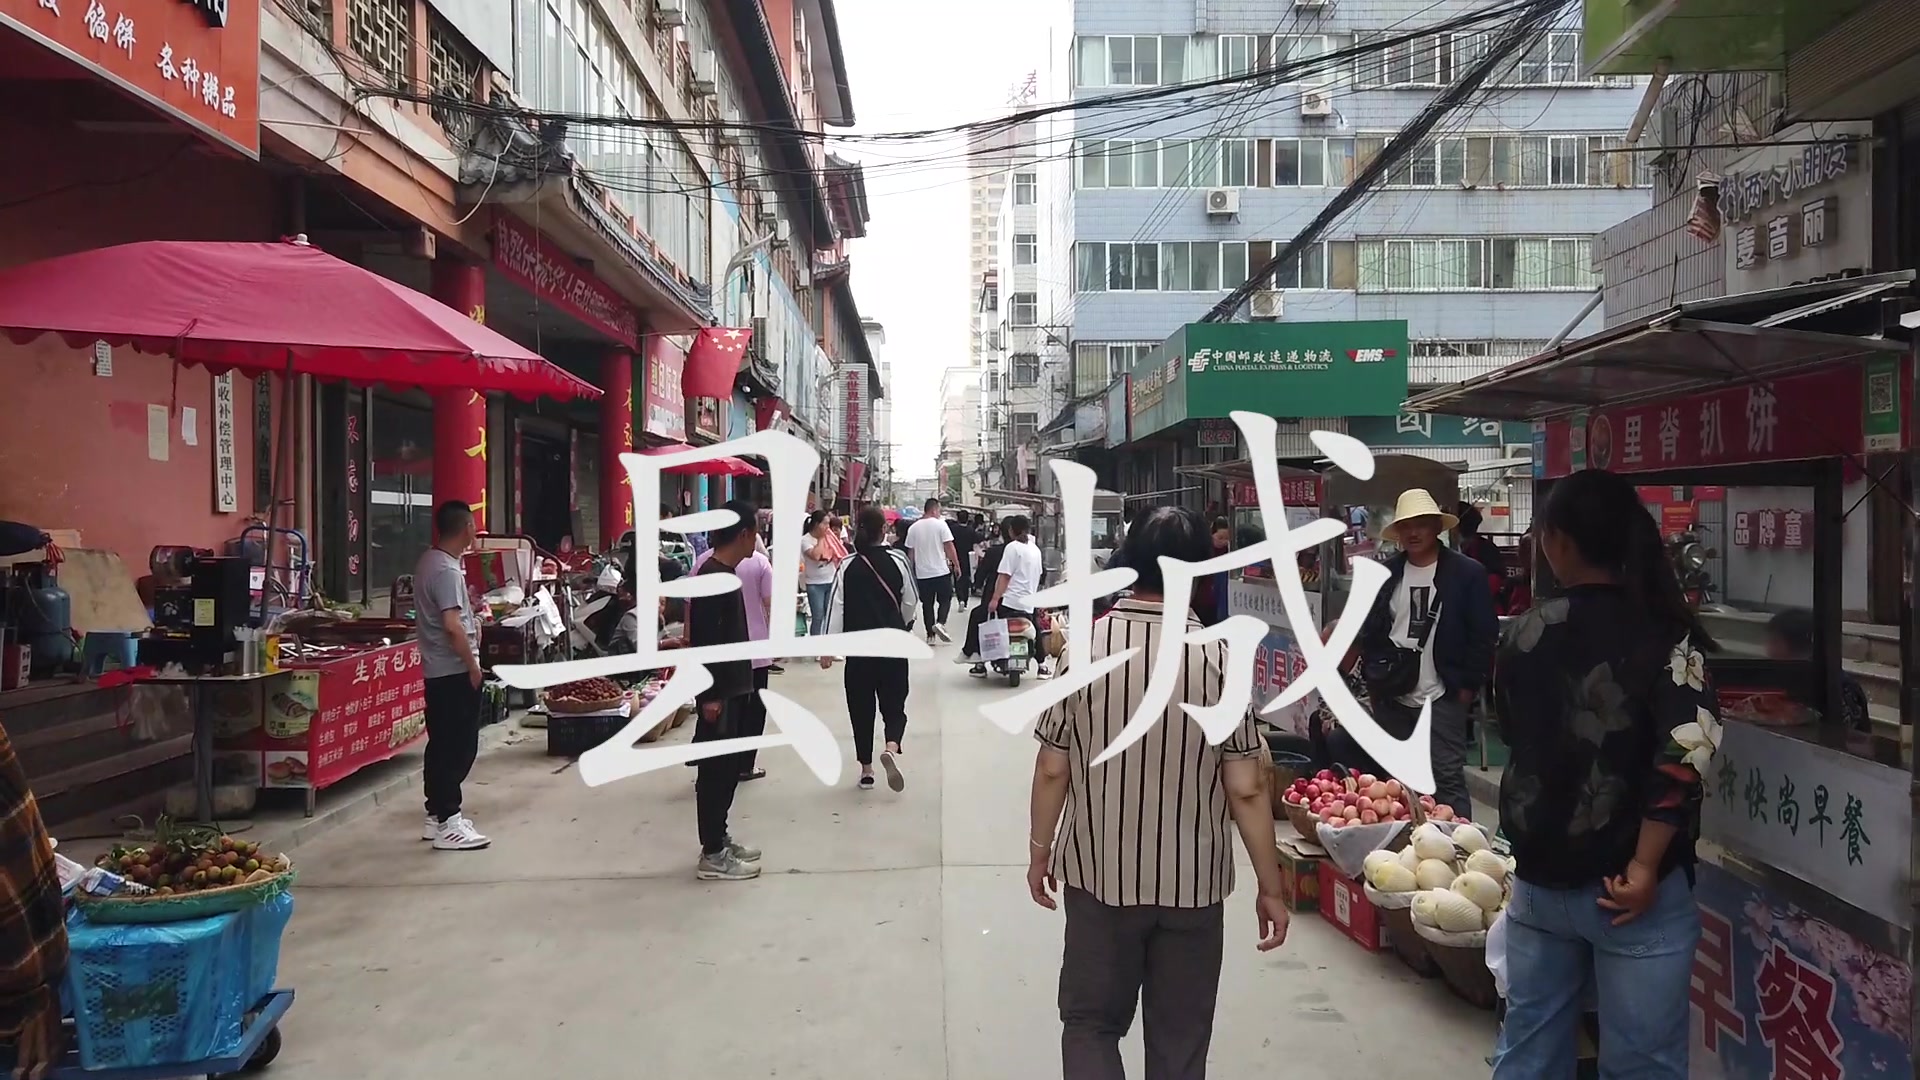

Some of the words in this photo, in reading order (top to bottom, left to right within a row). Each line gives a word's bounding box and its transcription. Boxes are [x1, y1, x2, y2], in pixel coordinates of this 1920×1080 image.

[84, 0, 137, 60] 馅饼
[157, 42, 237, 119] 各种粥品
[1737, 197, 1825, 270] 麦吉丽
[1211, 349, 1333, 365] 中国邮政速递物流
[1259, 363, 1287, 371] EXPRESS
[1294, 362, 1329, 370] LOGISTICS
[1622, 381, 1779, 464] 里脊扒饼
[1734, 508, 1803, 546] 品牌童
